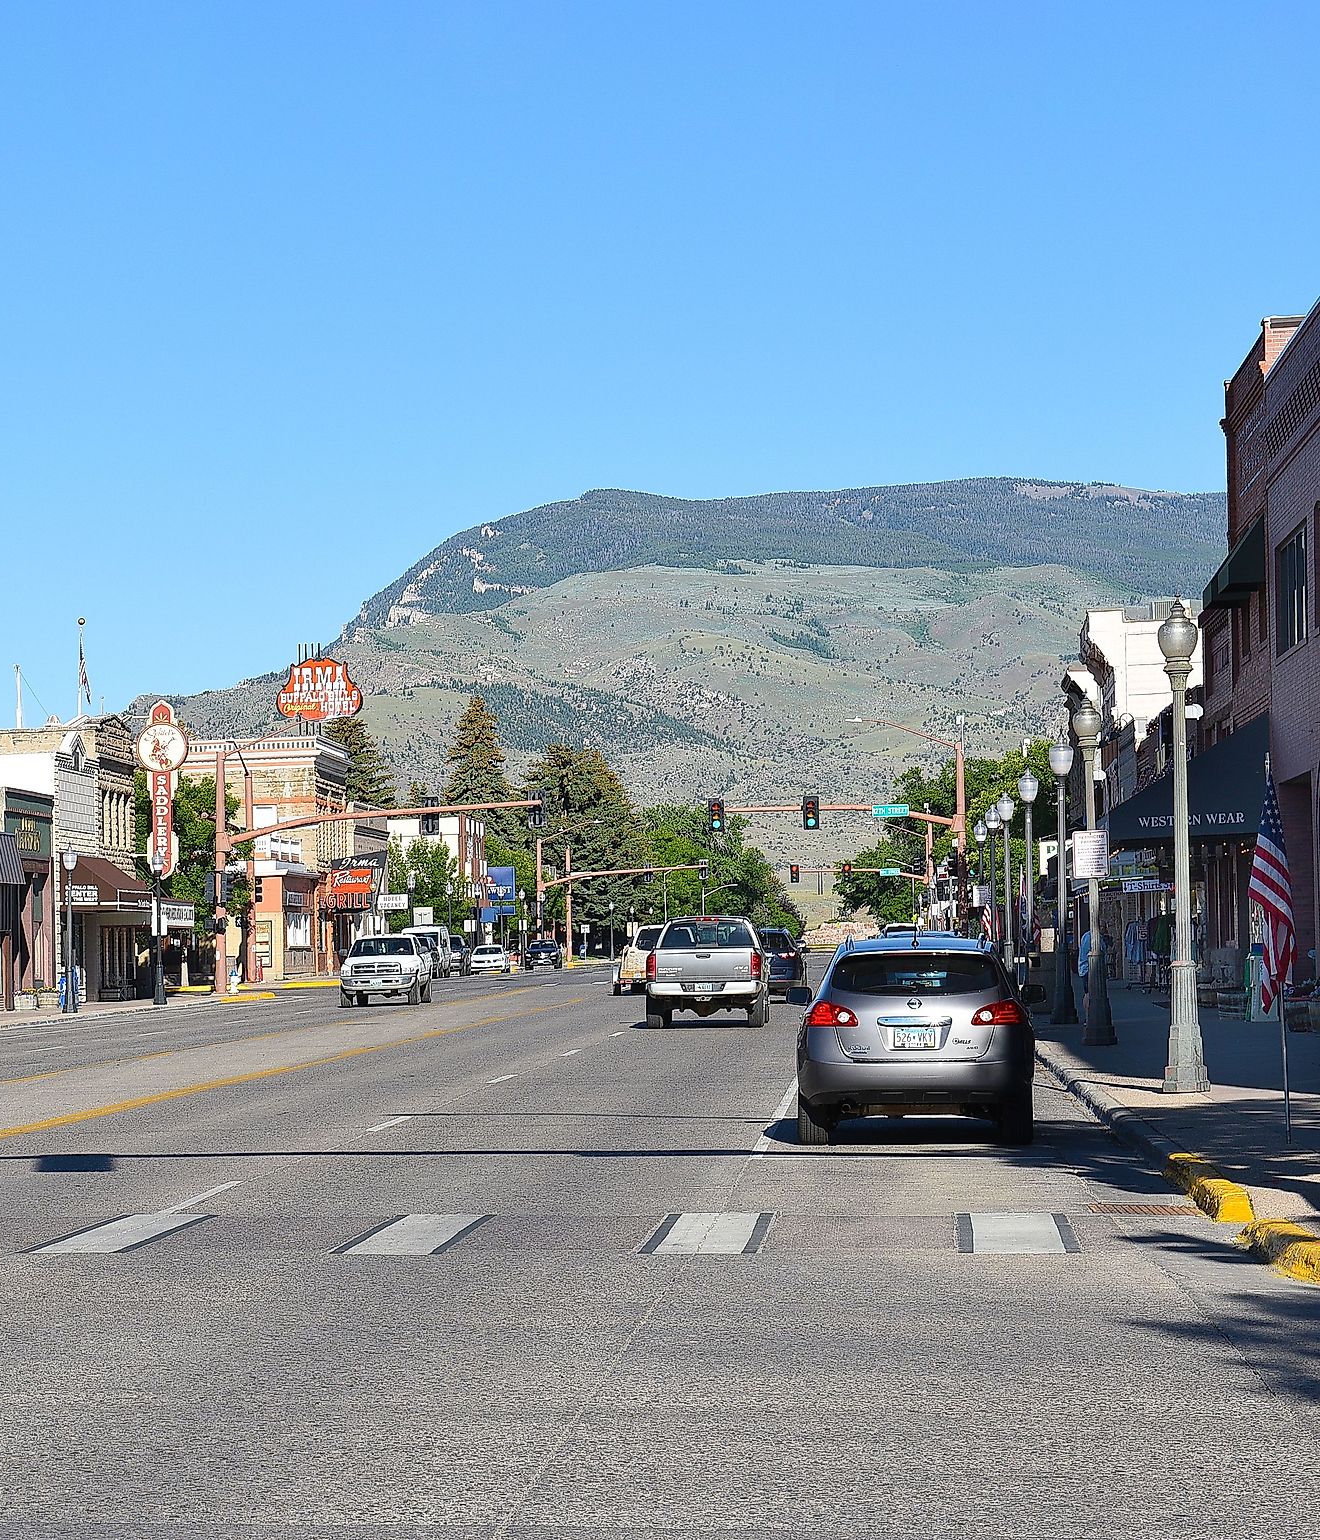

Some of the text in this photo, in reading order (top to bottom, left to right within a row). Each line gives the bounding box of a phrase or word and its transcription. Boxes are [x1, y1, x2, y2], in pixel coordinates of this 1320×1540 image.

[294, 666, 347, 691] IRMA
[283, 701, 356, 713] Original HOTEL
[155, 774, 169, 857] SADDLERY
[1139, 812, 1245, 828] WESTRN WEAR
[339, 857, 381, 870] Irma
[332, 870, 371, 888] Restaurant
[1129, 882, 1164, 891] T-Shirts
[326, 893, 371, 909] GRILL
[896, 1032, 934, 1042] 526 VKY
